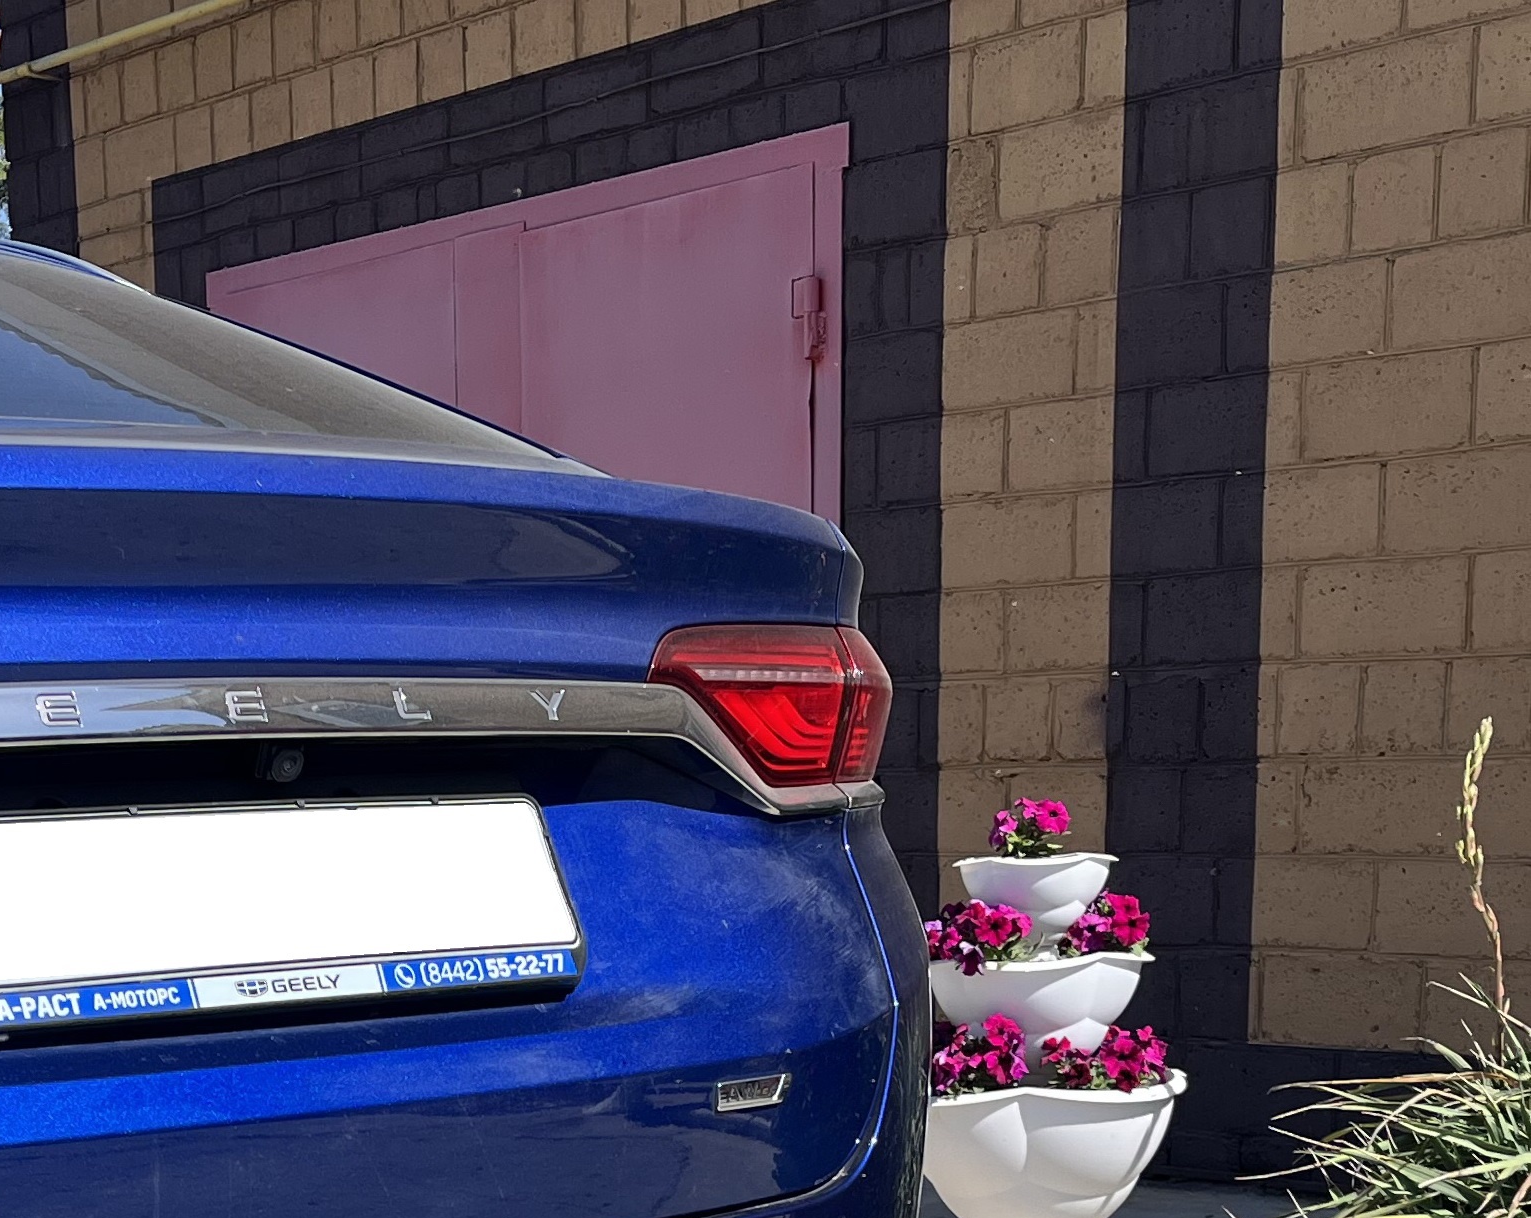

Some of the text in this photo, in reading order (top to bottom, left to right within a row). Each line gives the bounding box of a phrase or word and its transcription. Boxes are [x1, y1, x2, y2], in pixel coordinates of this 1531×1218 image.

[420, 953, 564, 987] (8442) 55-22-77
[272, 974, 340, 993] GEELY
[93, 987, 181, 1010] А-МОТОРС
